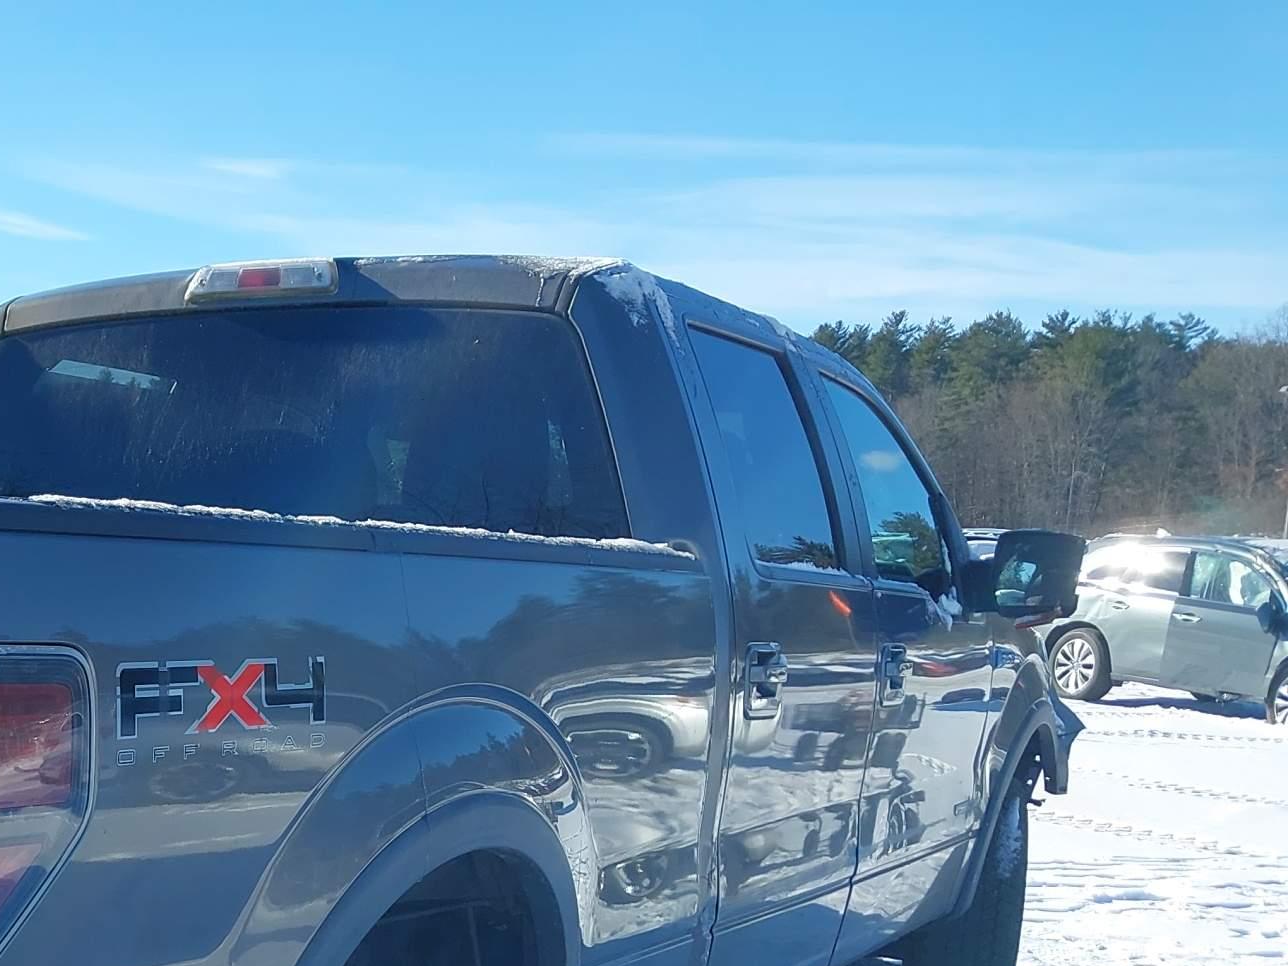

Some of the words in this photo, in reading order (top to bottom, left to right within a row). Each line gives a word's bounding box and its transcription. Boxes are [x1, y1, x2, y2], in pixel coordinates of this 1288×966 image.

[116, 656, 326, 740] FX4
[117, 743, 200, 766] OFF
[221, 733, 326, 756] ROAD
